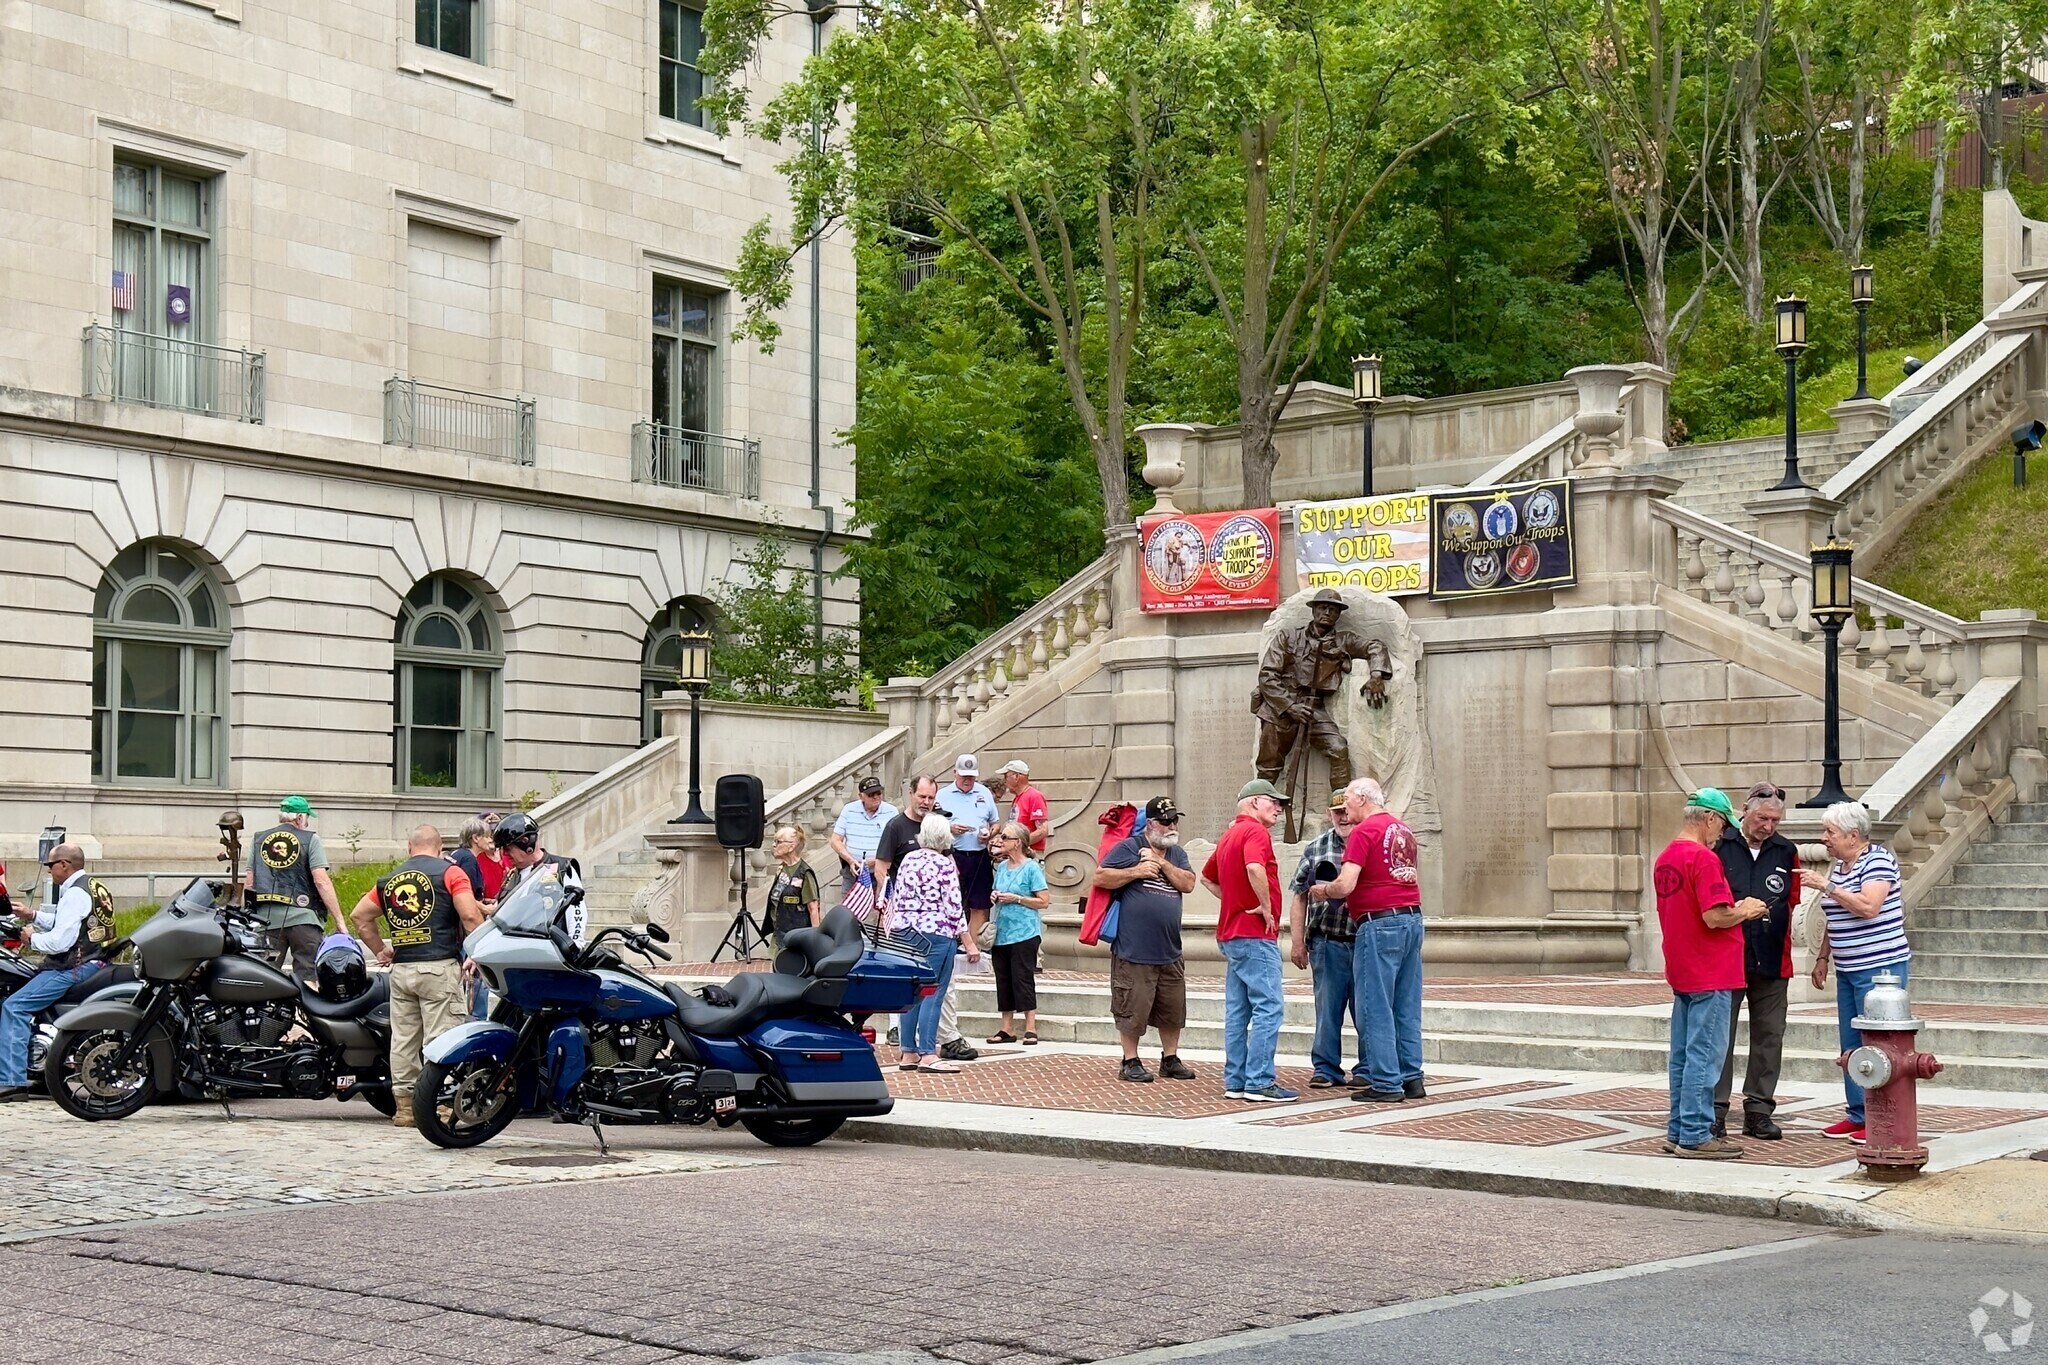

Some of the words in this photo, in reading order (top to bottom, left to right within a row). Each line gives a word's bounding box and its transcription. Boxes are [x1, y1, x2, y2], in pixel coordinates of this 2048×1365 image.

[1300, 495, 1429, 533] SUPPORT
[1224, 537, 1241, 547] HONK
[1244, 535, 1251, 545] IF
[1333, 533, 1395, 563] OUR
[1442, 539, 1460, 552] We
[1462, 536, 1503, 555] Support
[1527, 525, 1565, 542] Troops
[1223, 550, 1229, 561] U
[1229, 546, 1256, 560] SUPPORT
[1225, 559, 1256, 574] TROOPS
[1309, 563, 1421, 592] TROOPS
[264, 831, 298, 845] SUPPORTER
[262, 850, 282, 867] COMBAT
[283, 850, 297, 866] VETS
[385, 872, 417, 897] COMBAT
[416, 873, 431, 892] VETS
[387, 902, 432, 927] ASSOCIATION
[340, 1077, 346, 1085] 7
[718, 1099, 724, 1108] 3
